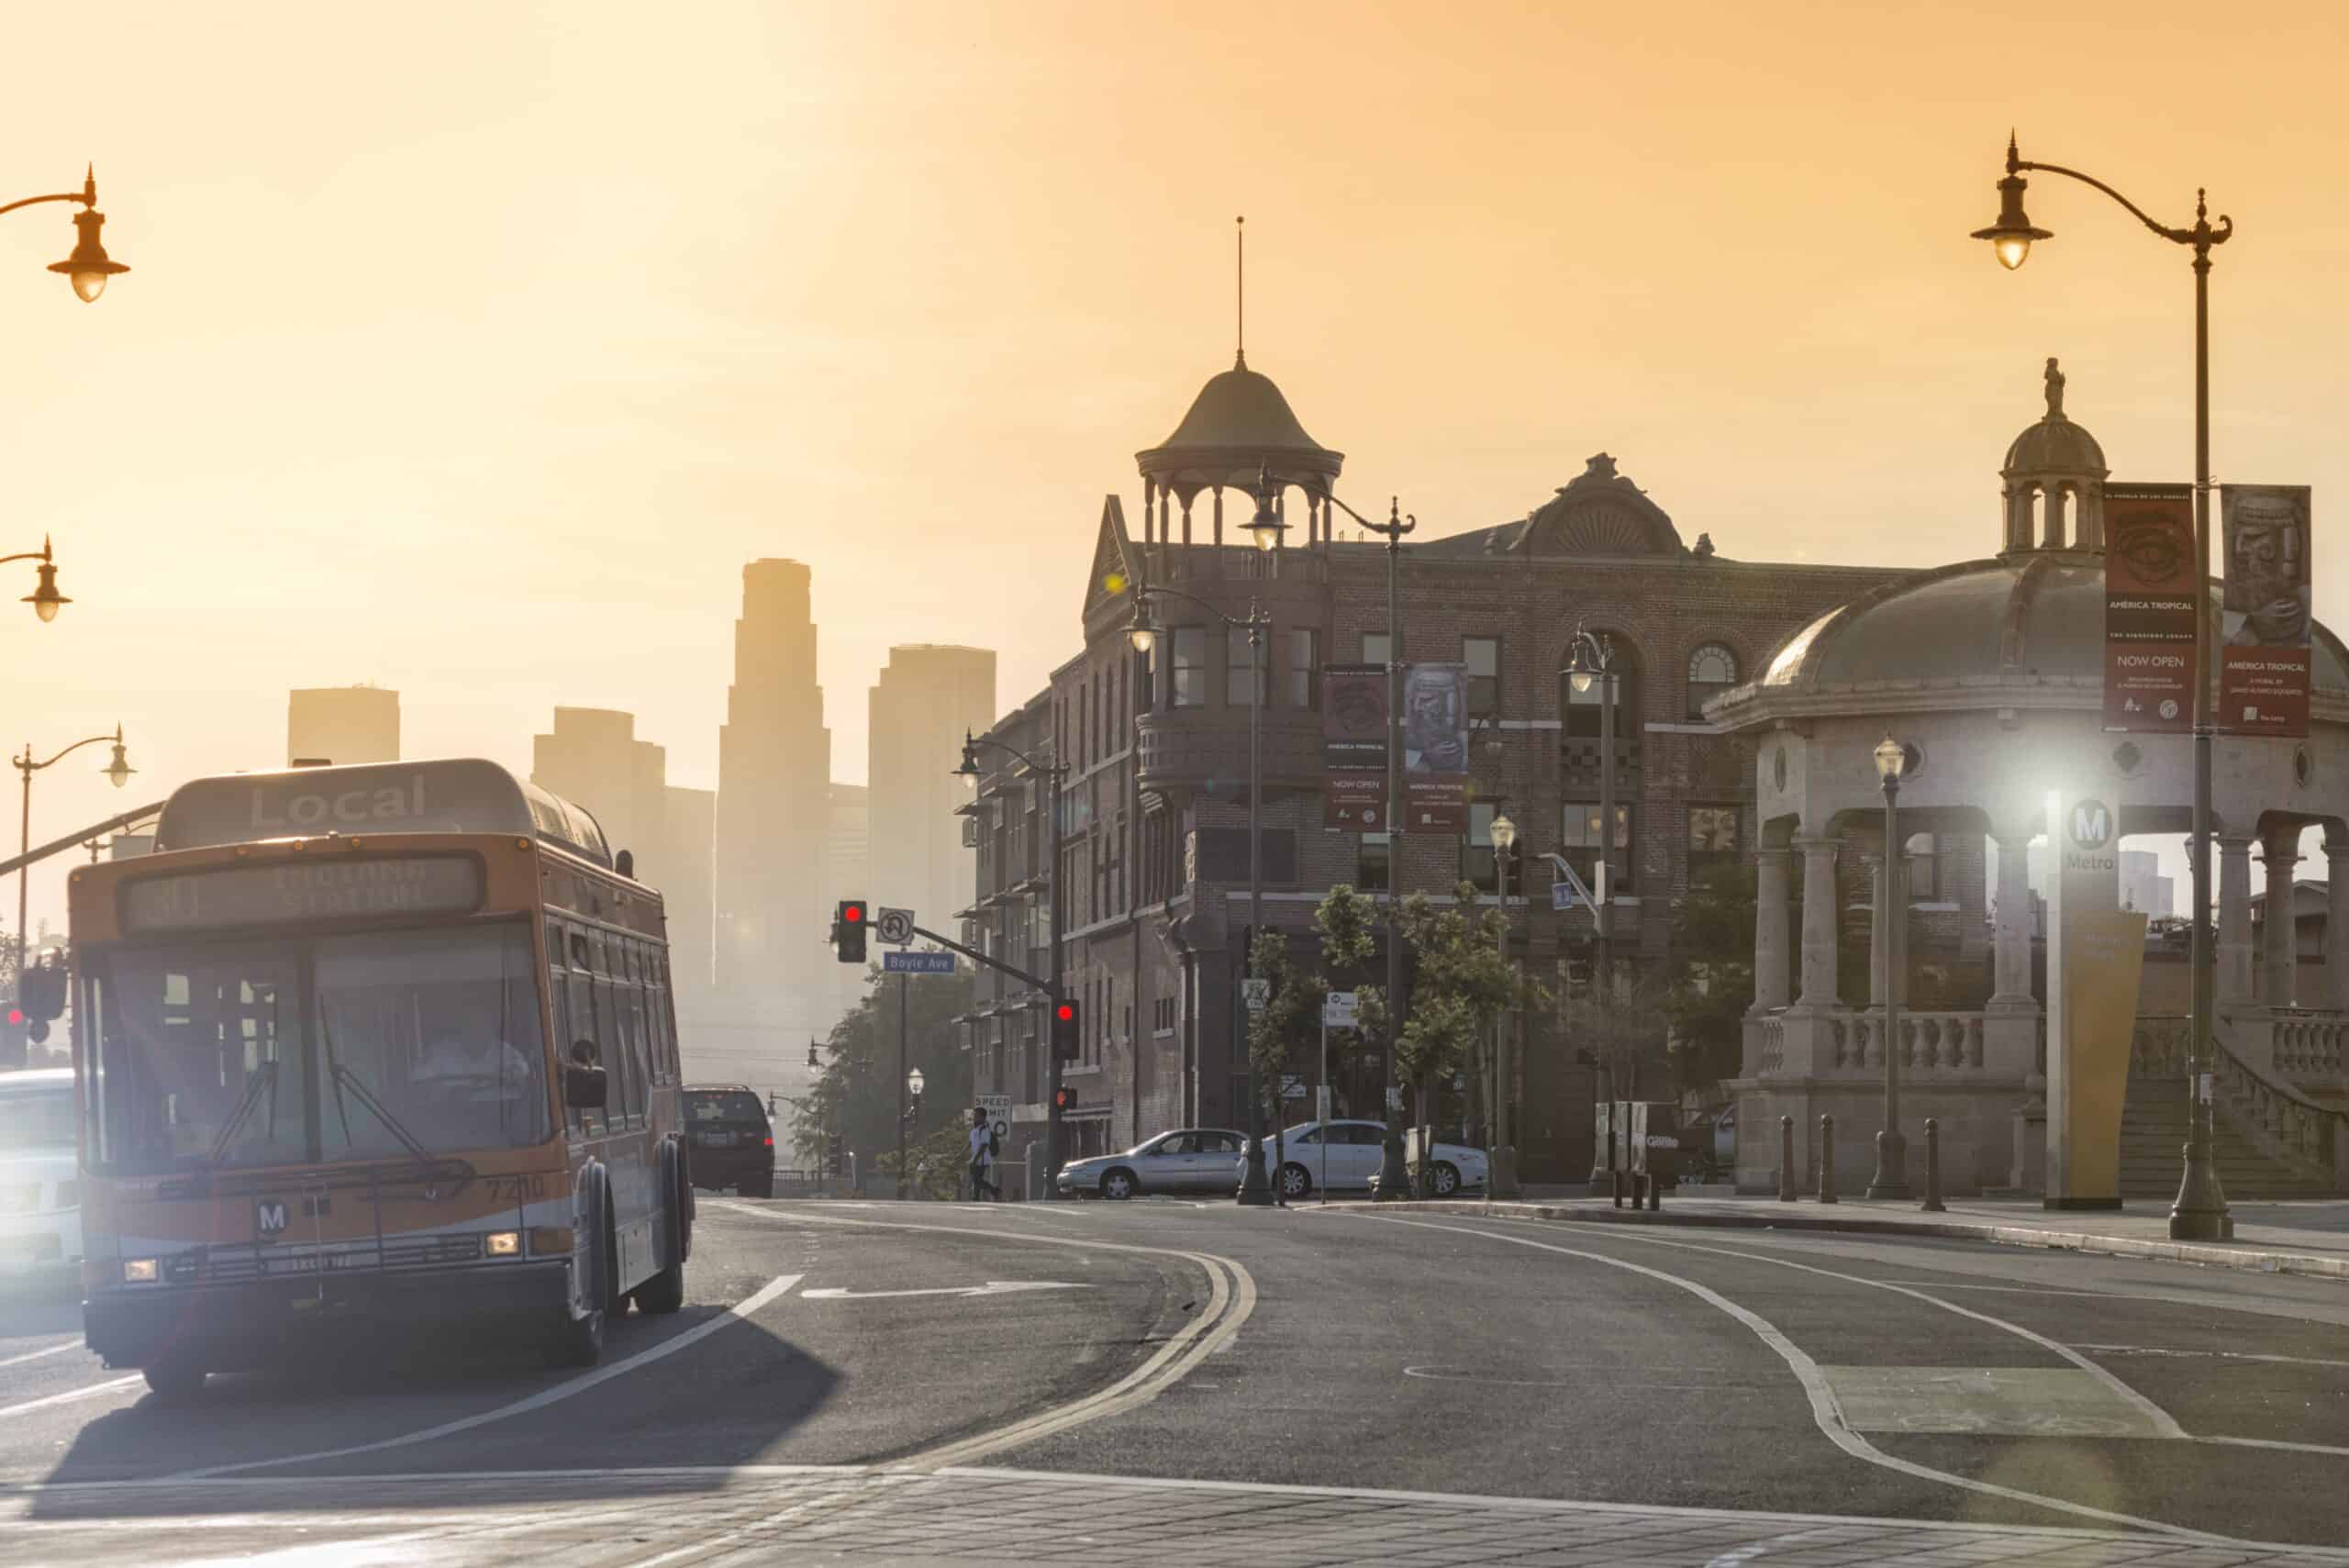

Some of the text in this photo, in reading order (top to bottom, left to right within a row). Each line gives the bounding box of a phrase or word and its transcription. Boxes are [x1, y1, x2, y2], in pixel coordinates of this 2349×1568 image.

[2151, 601, 2194, 610] TROPICAL
[2117, 655, 2185, 668] NOW OPEN
[2266, 662, 2305, 672] TROPICAL
[1332, 780, 1380, 789] NOW OPEN
[251, 774, 426, 828] Local
[2076, 807, 2106, 841] M
[2067, 852, 2114, 871] Metro
[890, 955, 949, 971] Boyle Ave
[975, 1096, 1009, 1106] SPEED
[259, 1204, 285, 1230] M
